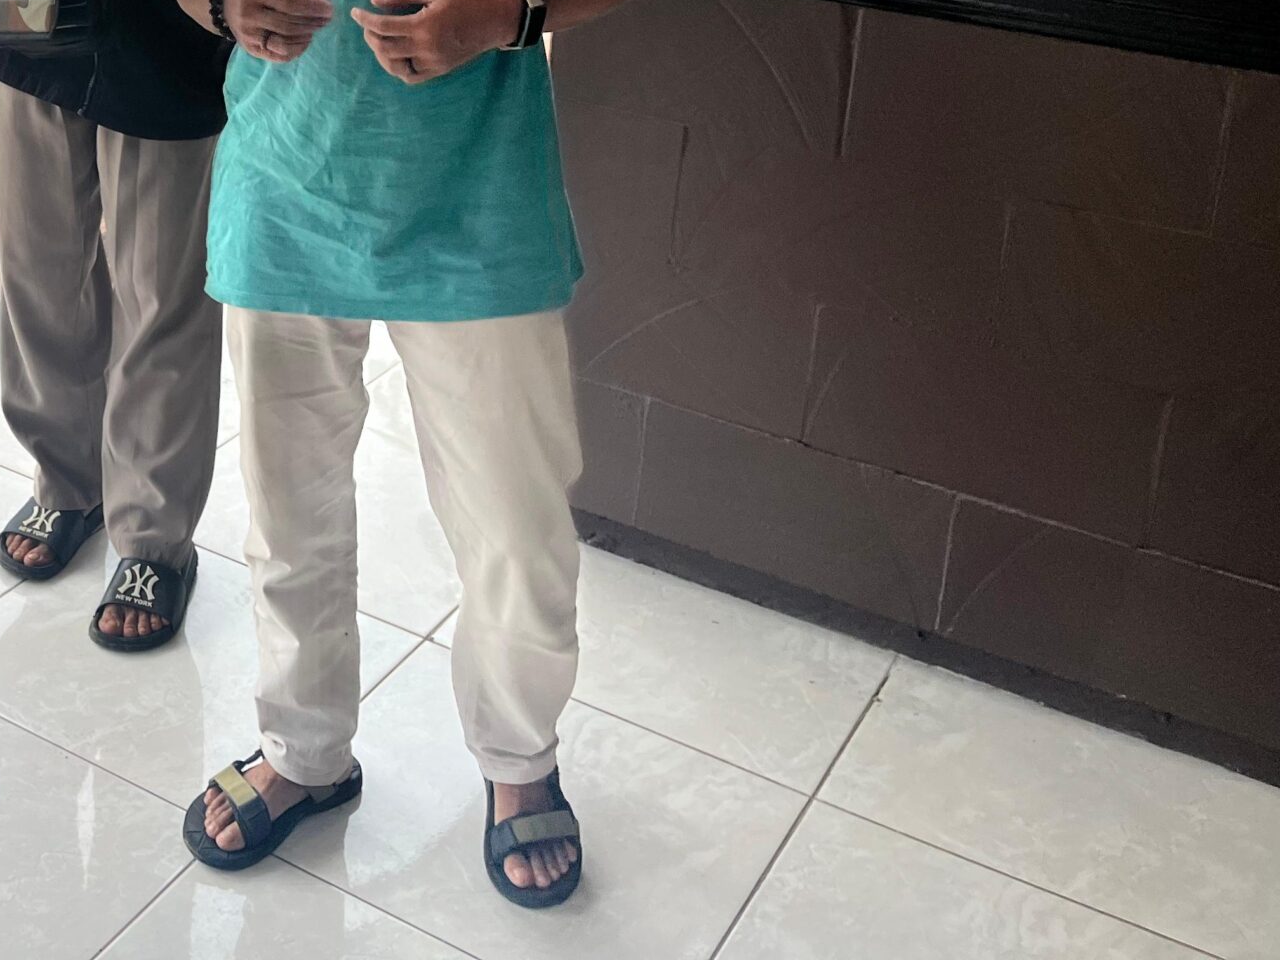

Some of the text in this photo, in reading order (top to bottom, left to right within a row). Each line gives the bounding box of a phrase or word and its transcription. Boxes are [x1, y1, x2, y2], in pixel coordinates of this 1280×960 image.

[32, 530, 49, 538] YORK
[115, 593, 153, 608] NEW YORK
